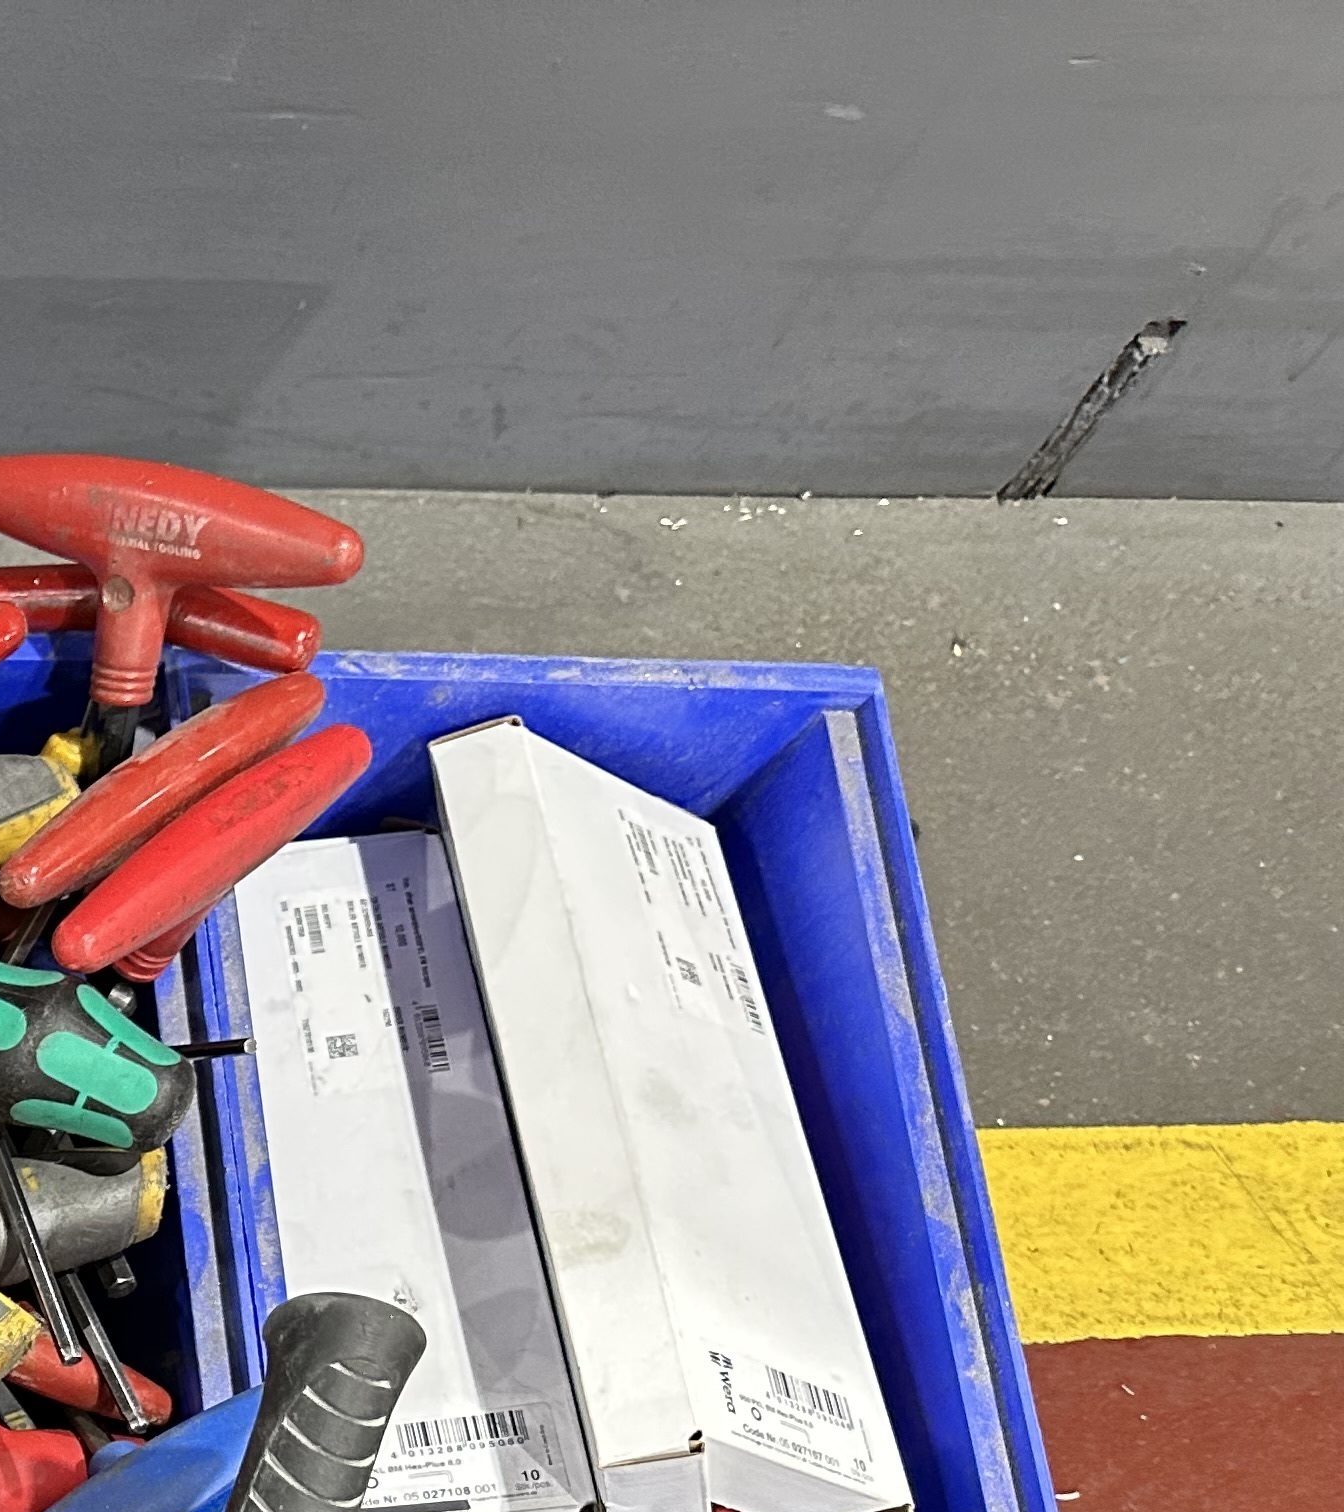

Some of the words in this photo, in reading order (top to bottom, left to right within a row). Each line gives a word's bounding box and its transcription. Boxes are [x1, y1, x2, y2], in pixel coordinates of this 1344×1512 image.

[719, 1370, 736, 1415] Wera
[521, 1469, 540, 1481] 10
[422, 1486, 471, 1500] 027108
[474, 1483, 497, 1495] 001
